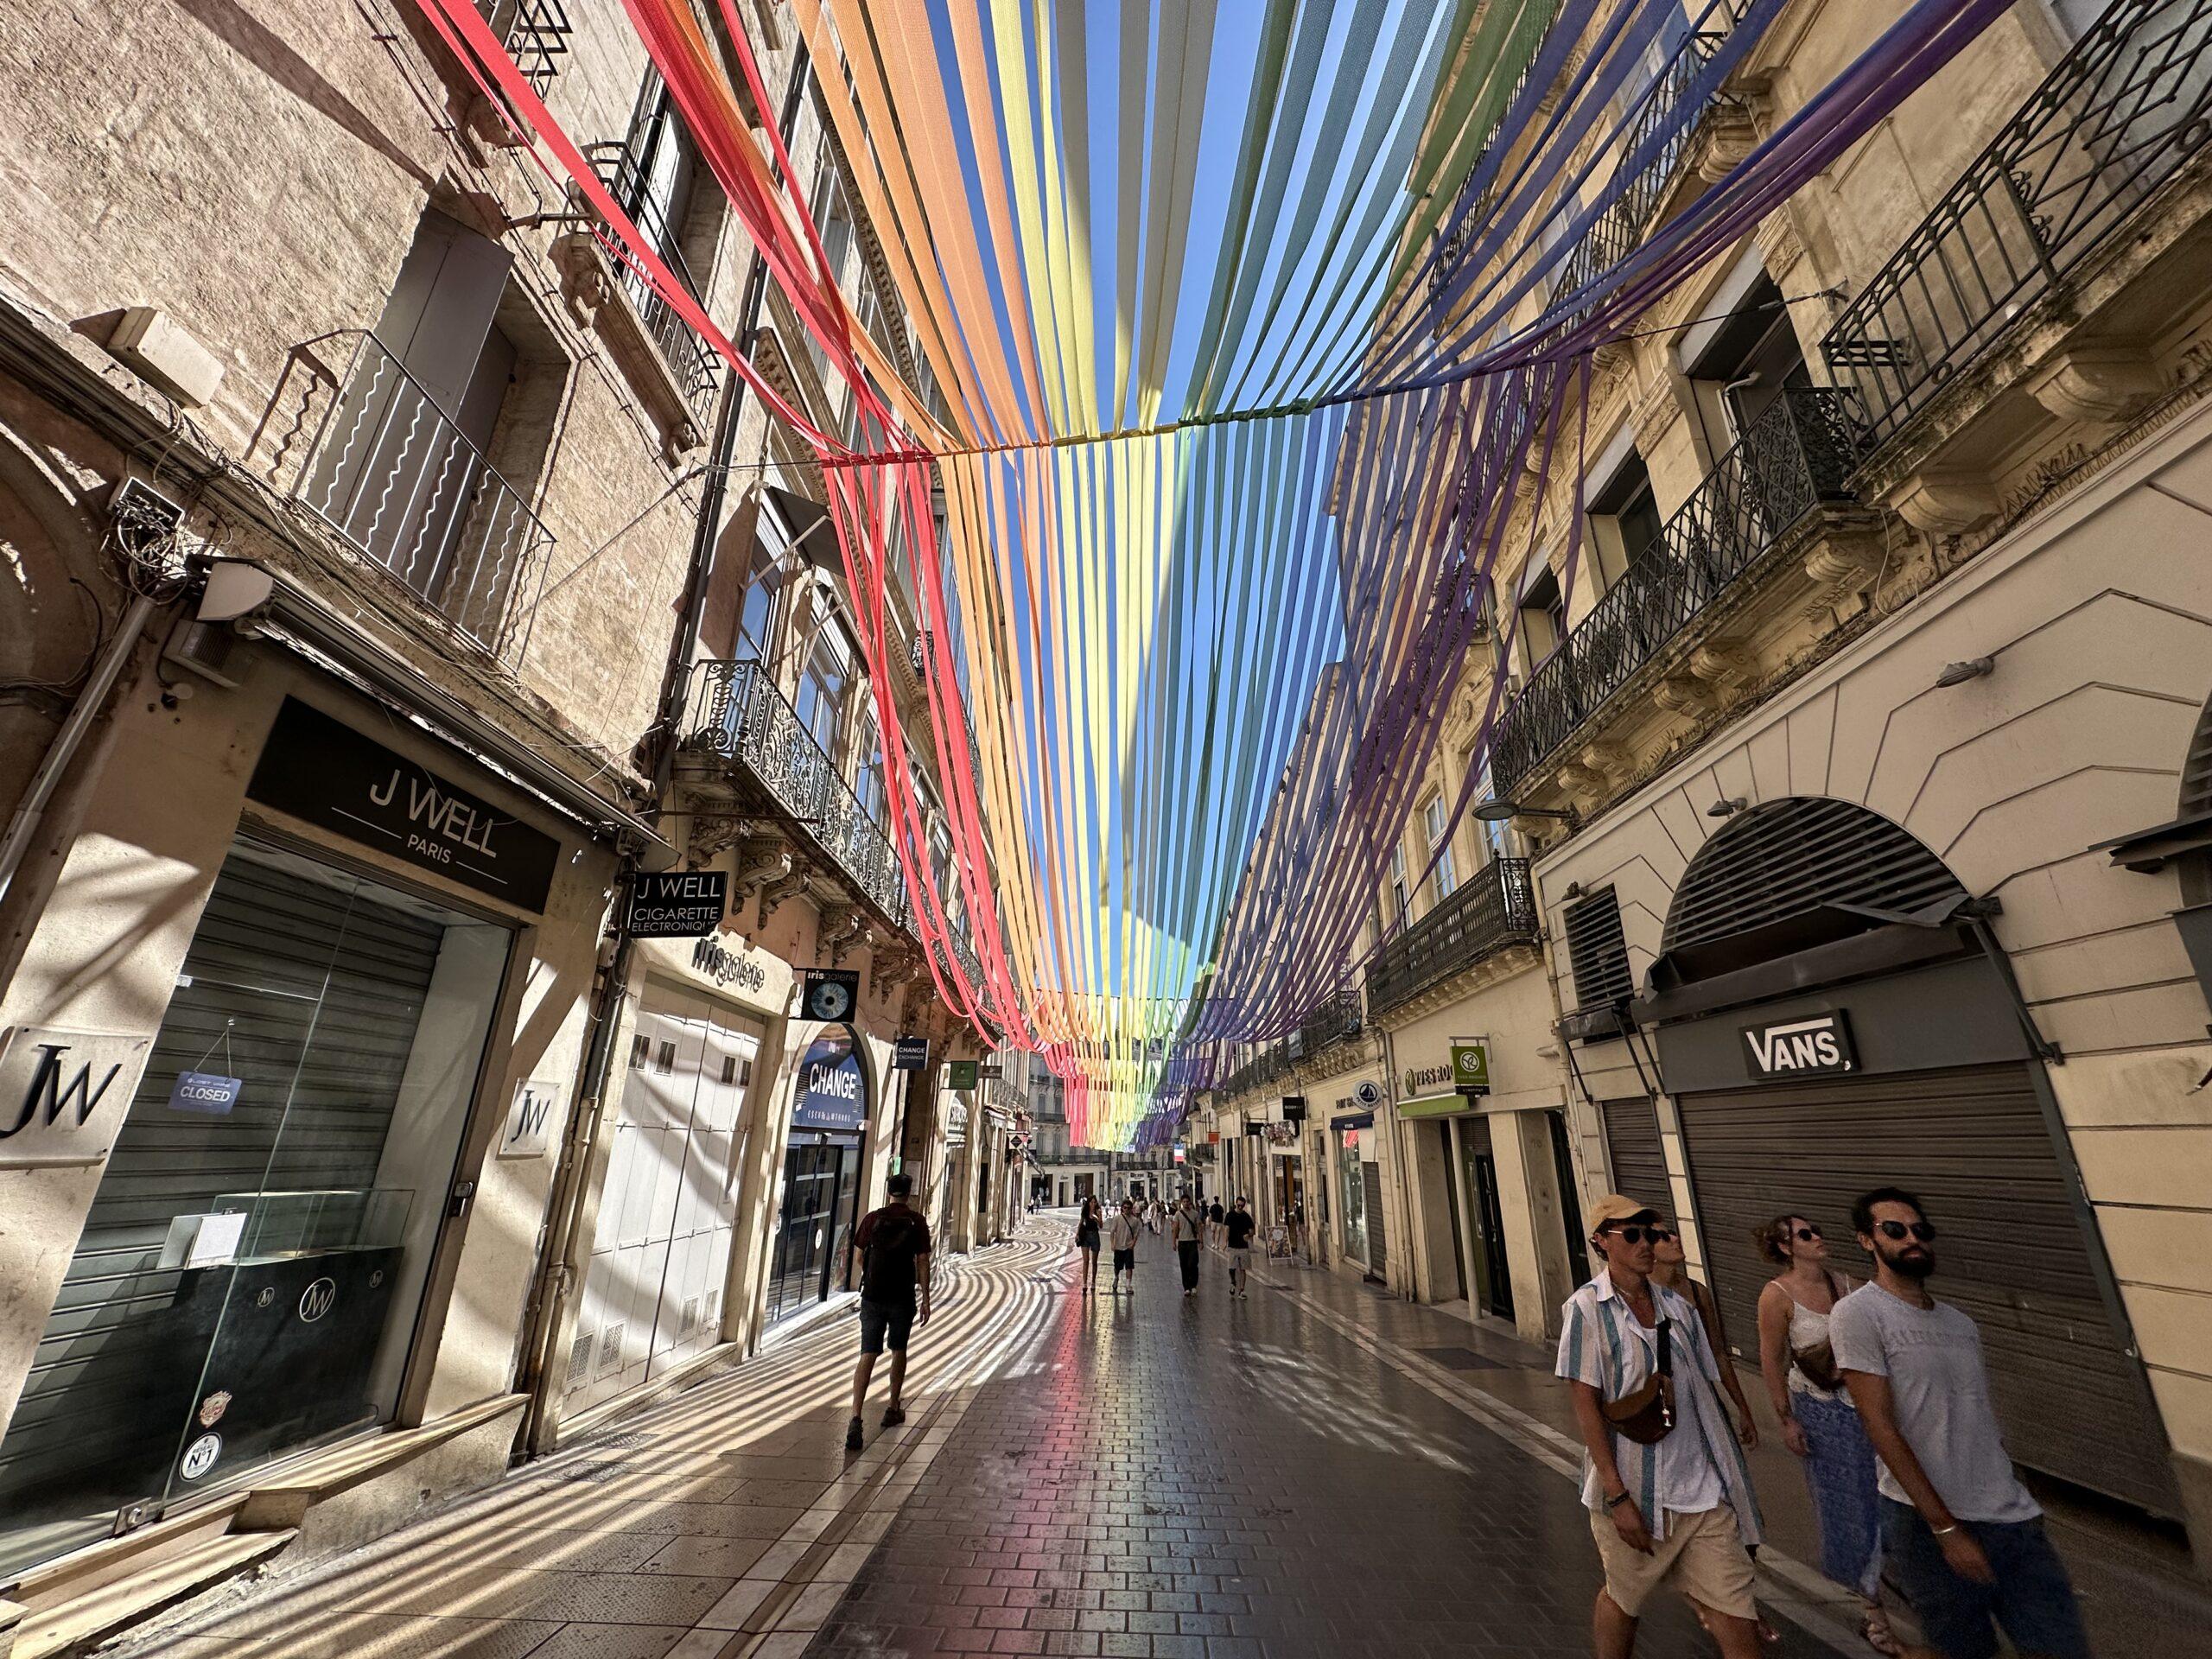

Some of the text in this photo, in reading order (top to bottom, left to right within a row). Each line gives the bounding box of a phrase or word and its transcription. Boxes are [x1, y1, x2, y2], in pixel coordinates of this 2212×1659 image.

[370, 769, 497, 859] J WELL
[407, 834, 451, 864] PARIS
[638, 876, 721, 899] J WELL
[632, 921, 716, 932] ELECTRONIQ
[633, 906, 719, 921] CIGARETTE
[1745, 1017, 1840, 1071] VANS
[180, 1086, 231, 1103] CLOSED
[810, 1063, 857, 1100] CHANGE
